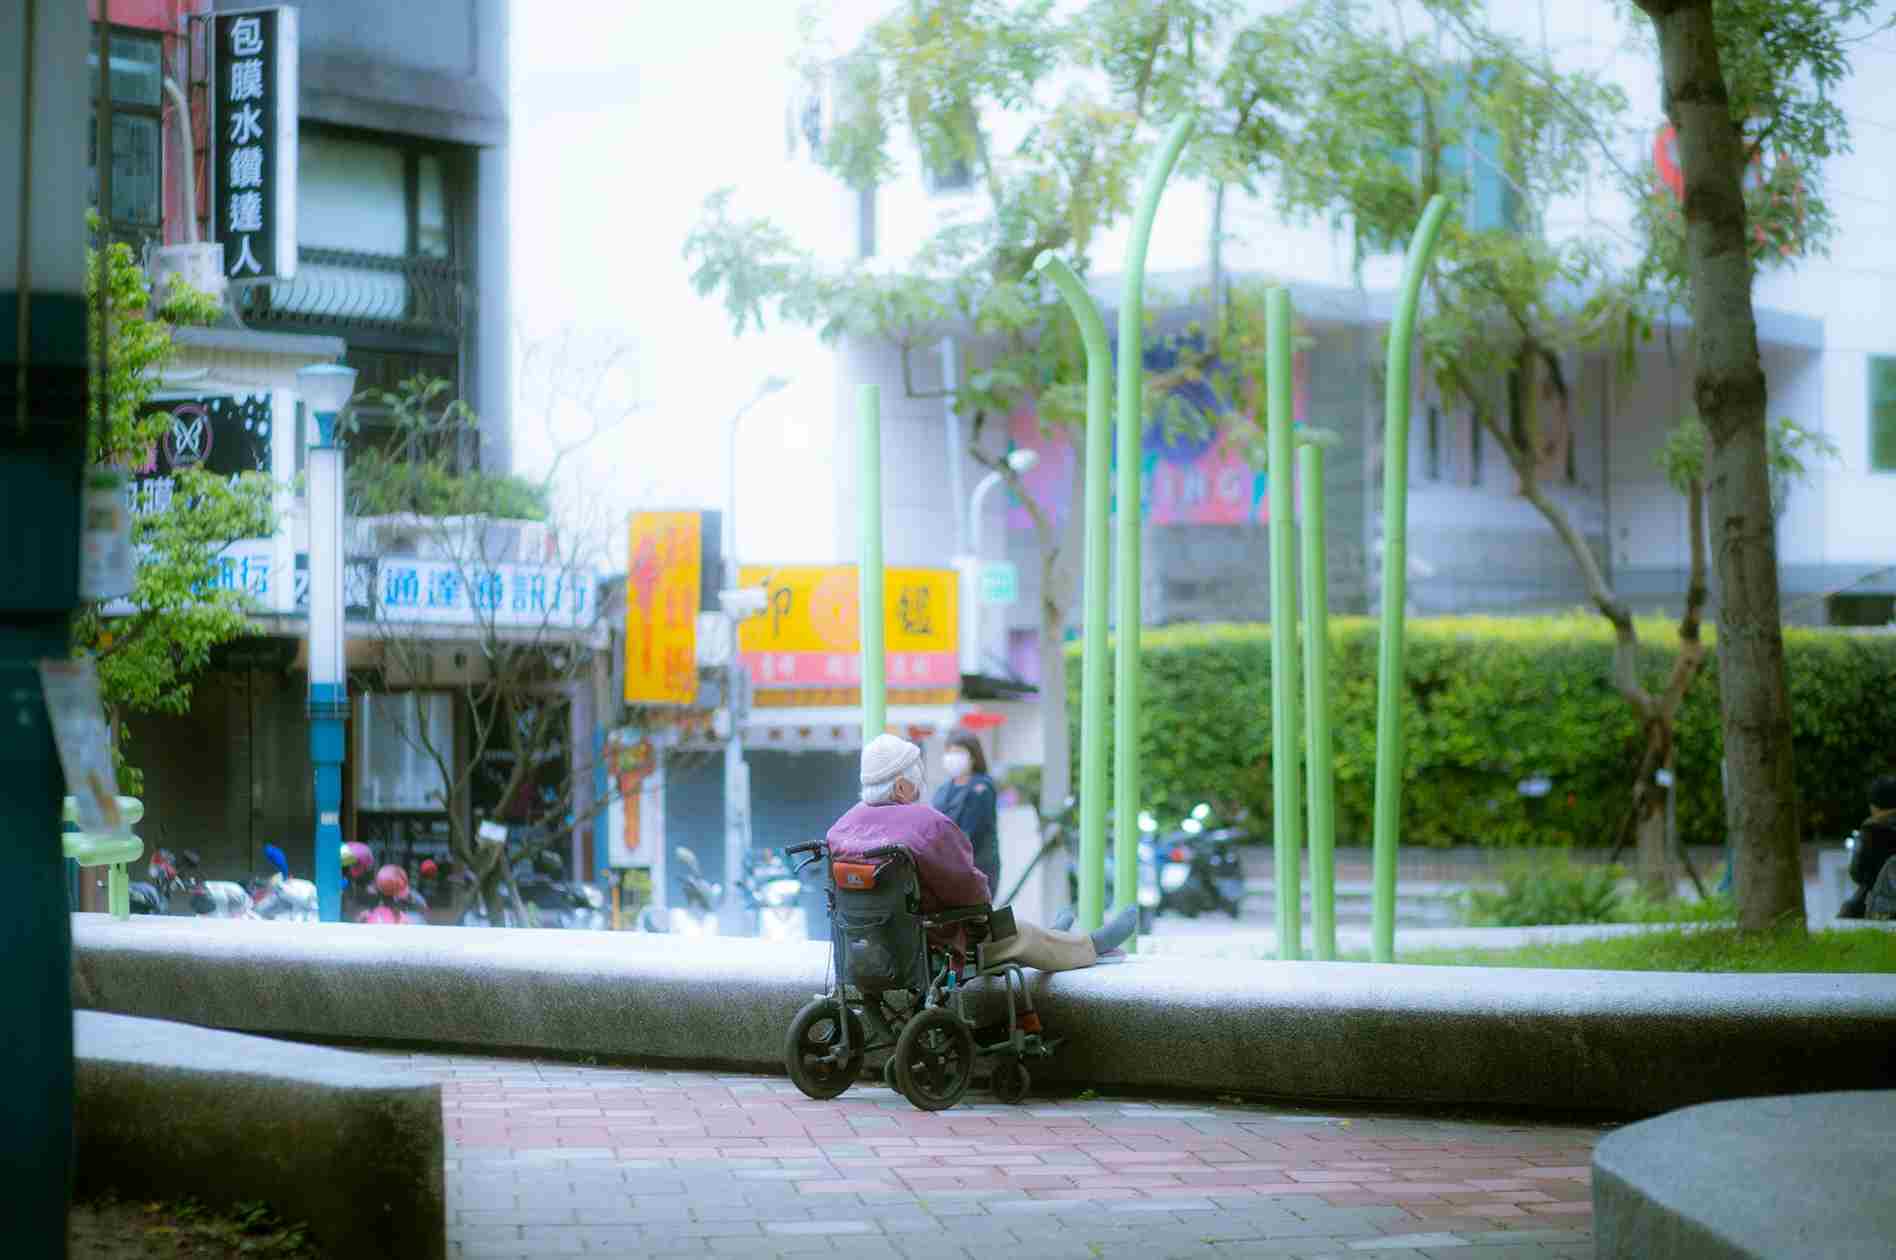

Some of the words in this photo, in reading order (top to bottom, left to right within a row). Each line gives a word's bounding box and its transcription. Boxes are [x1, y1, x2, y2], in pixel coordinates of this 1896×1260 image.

[229, 16, 264, 276] 包膜水鑽達人
[383, 566, 591, 613] 通達通訊行
